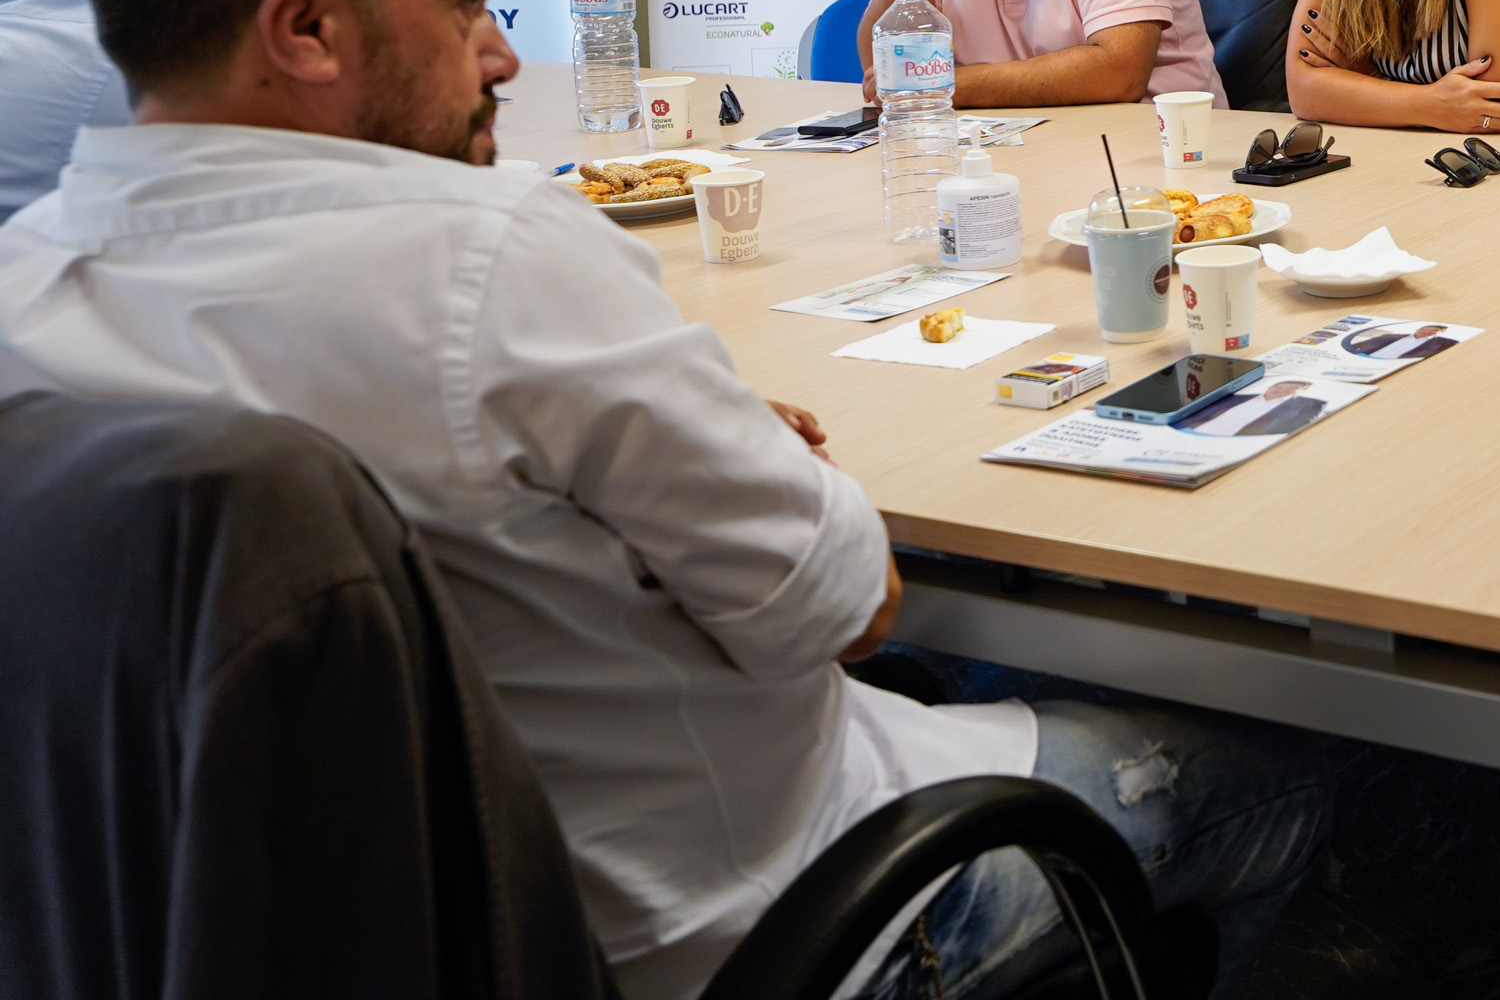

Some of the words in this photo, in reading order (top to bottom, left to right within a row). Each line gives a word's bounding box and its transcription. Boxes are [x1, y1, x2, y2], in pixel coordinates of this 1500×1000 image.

[681, 2, 748, 16] LUCART
[706, 30, 763, 39] ECONATURAL
[722, 231, 760, 247] Douwe
